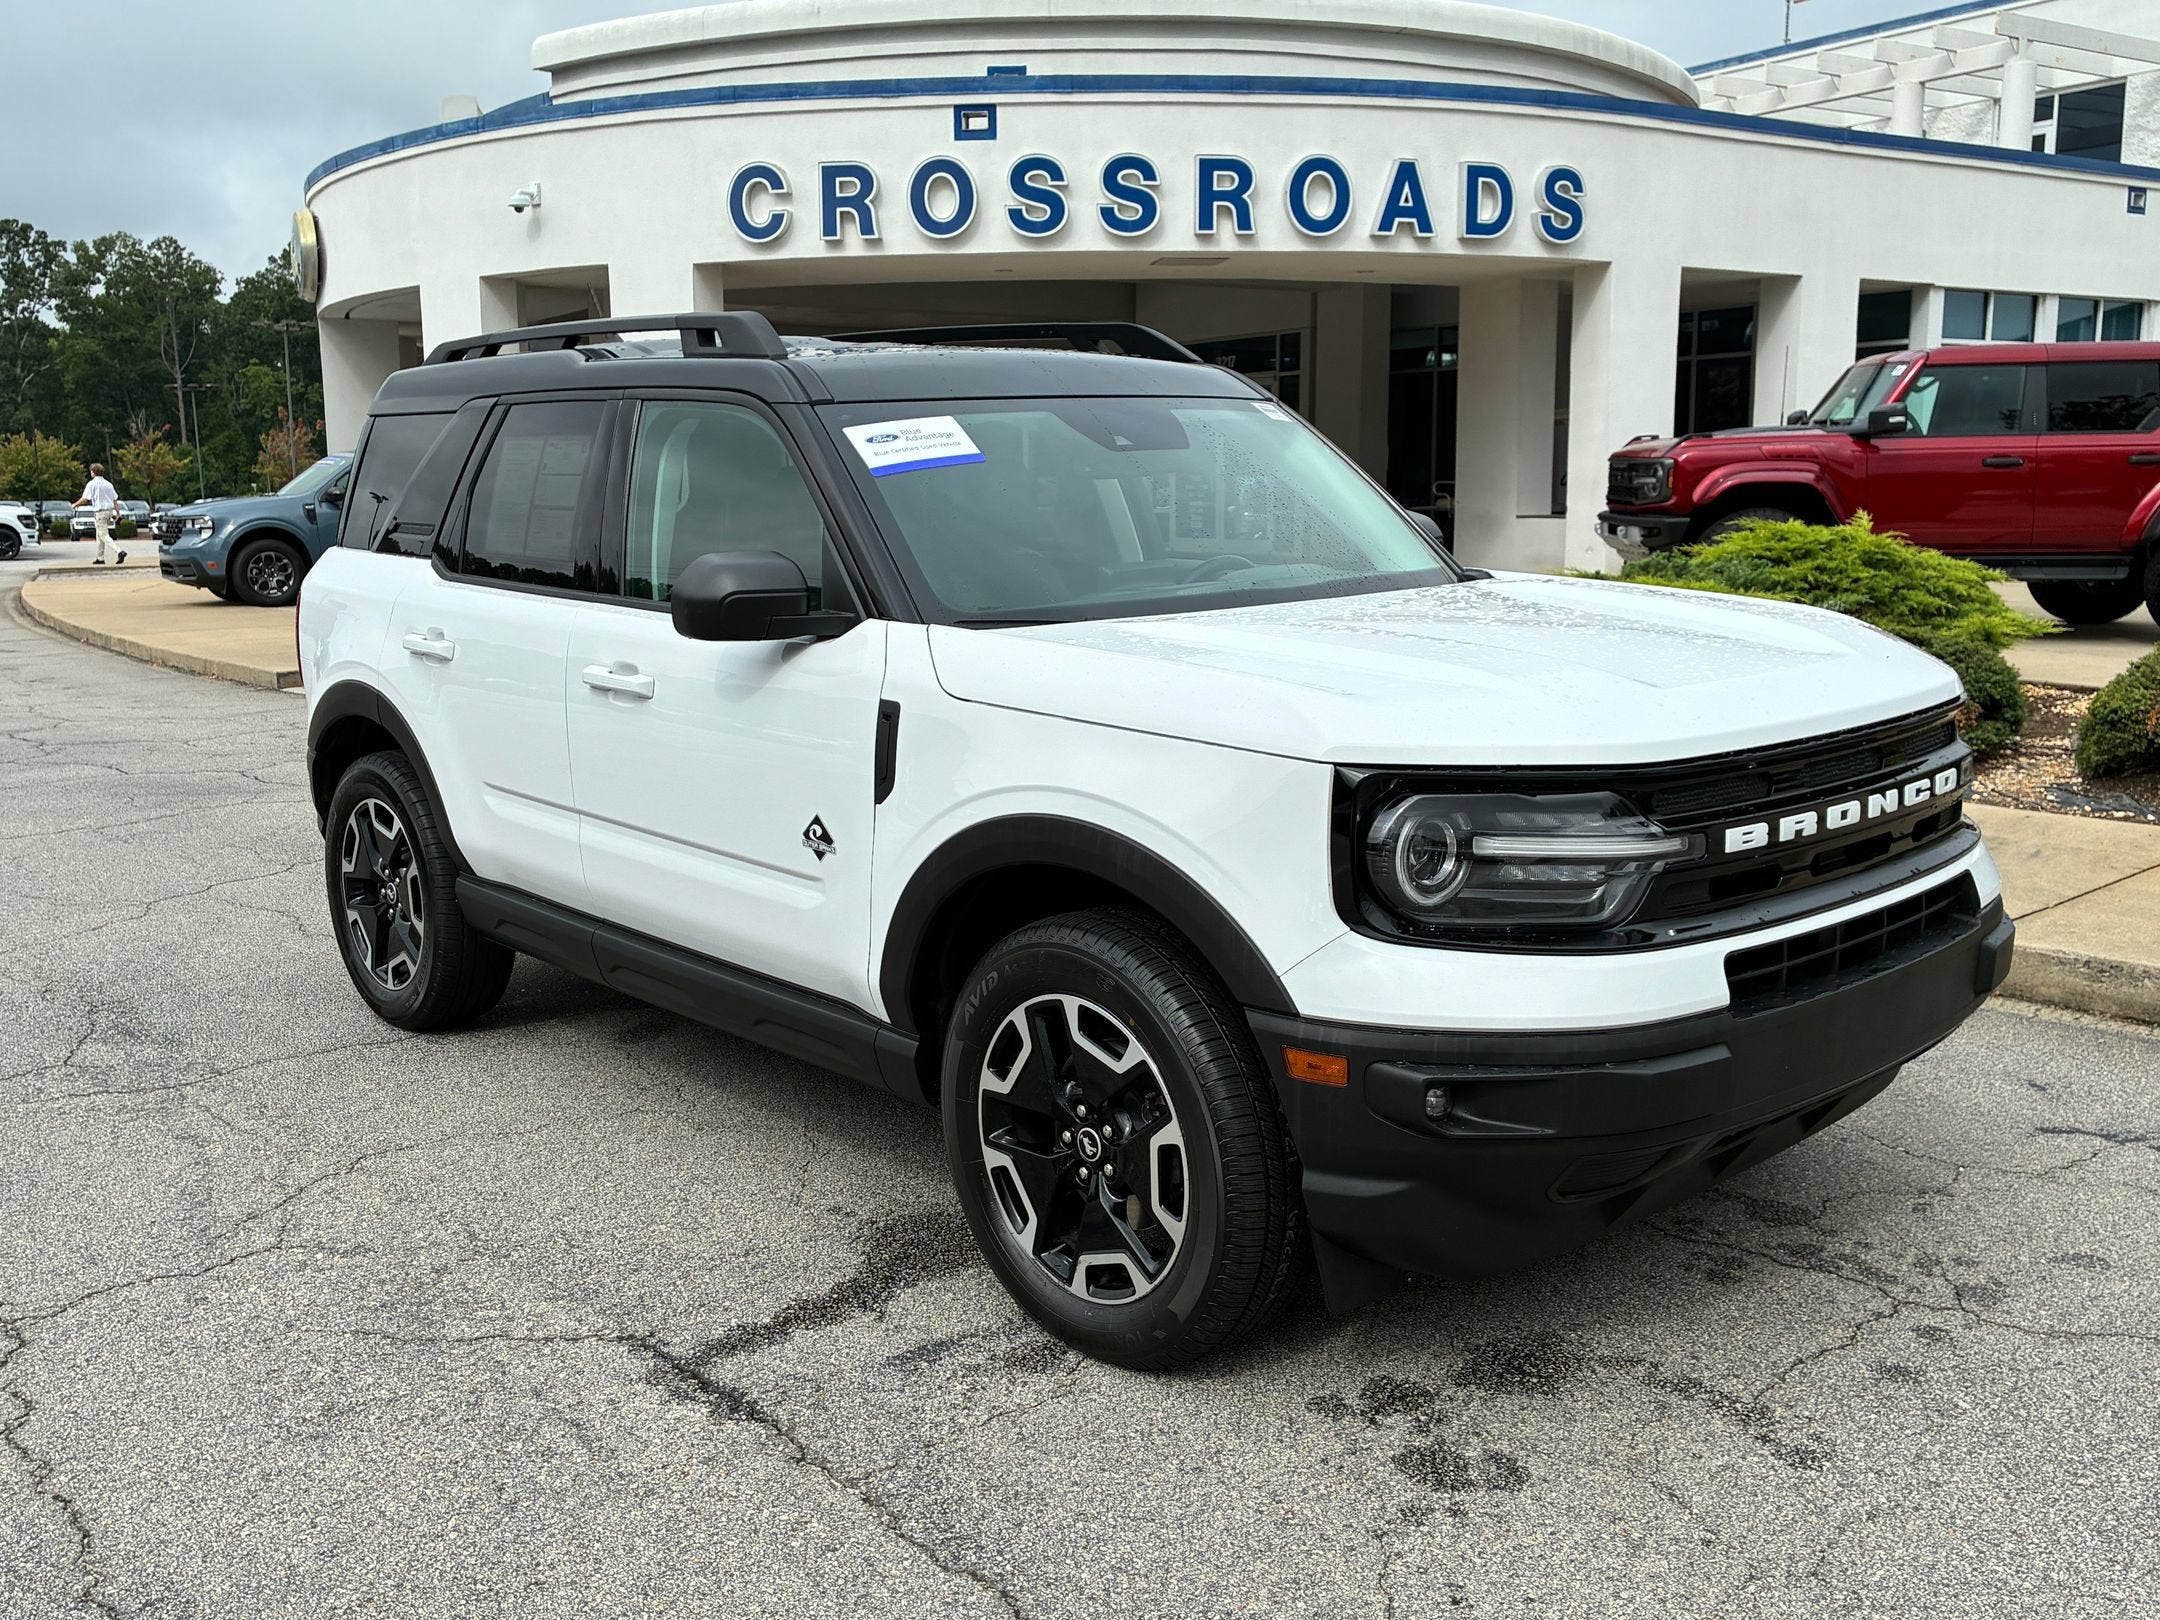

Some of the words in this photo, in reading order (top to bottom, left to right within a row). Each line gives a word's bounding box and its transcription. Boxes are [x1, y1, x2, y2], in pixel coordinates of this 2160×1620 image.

[727, 153, 1588, 244] CROSSROADS
[900, 428, 922, 436] Blue
[905, 431, 955, 442] Advantage
[873, 449, 890, 457] Blue
[890, 445, 920, 455] Certified
[1724, 767, 1958, 854] BRONCO
[963, 970, 999, 1027] AVID
